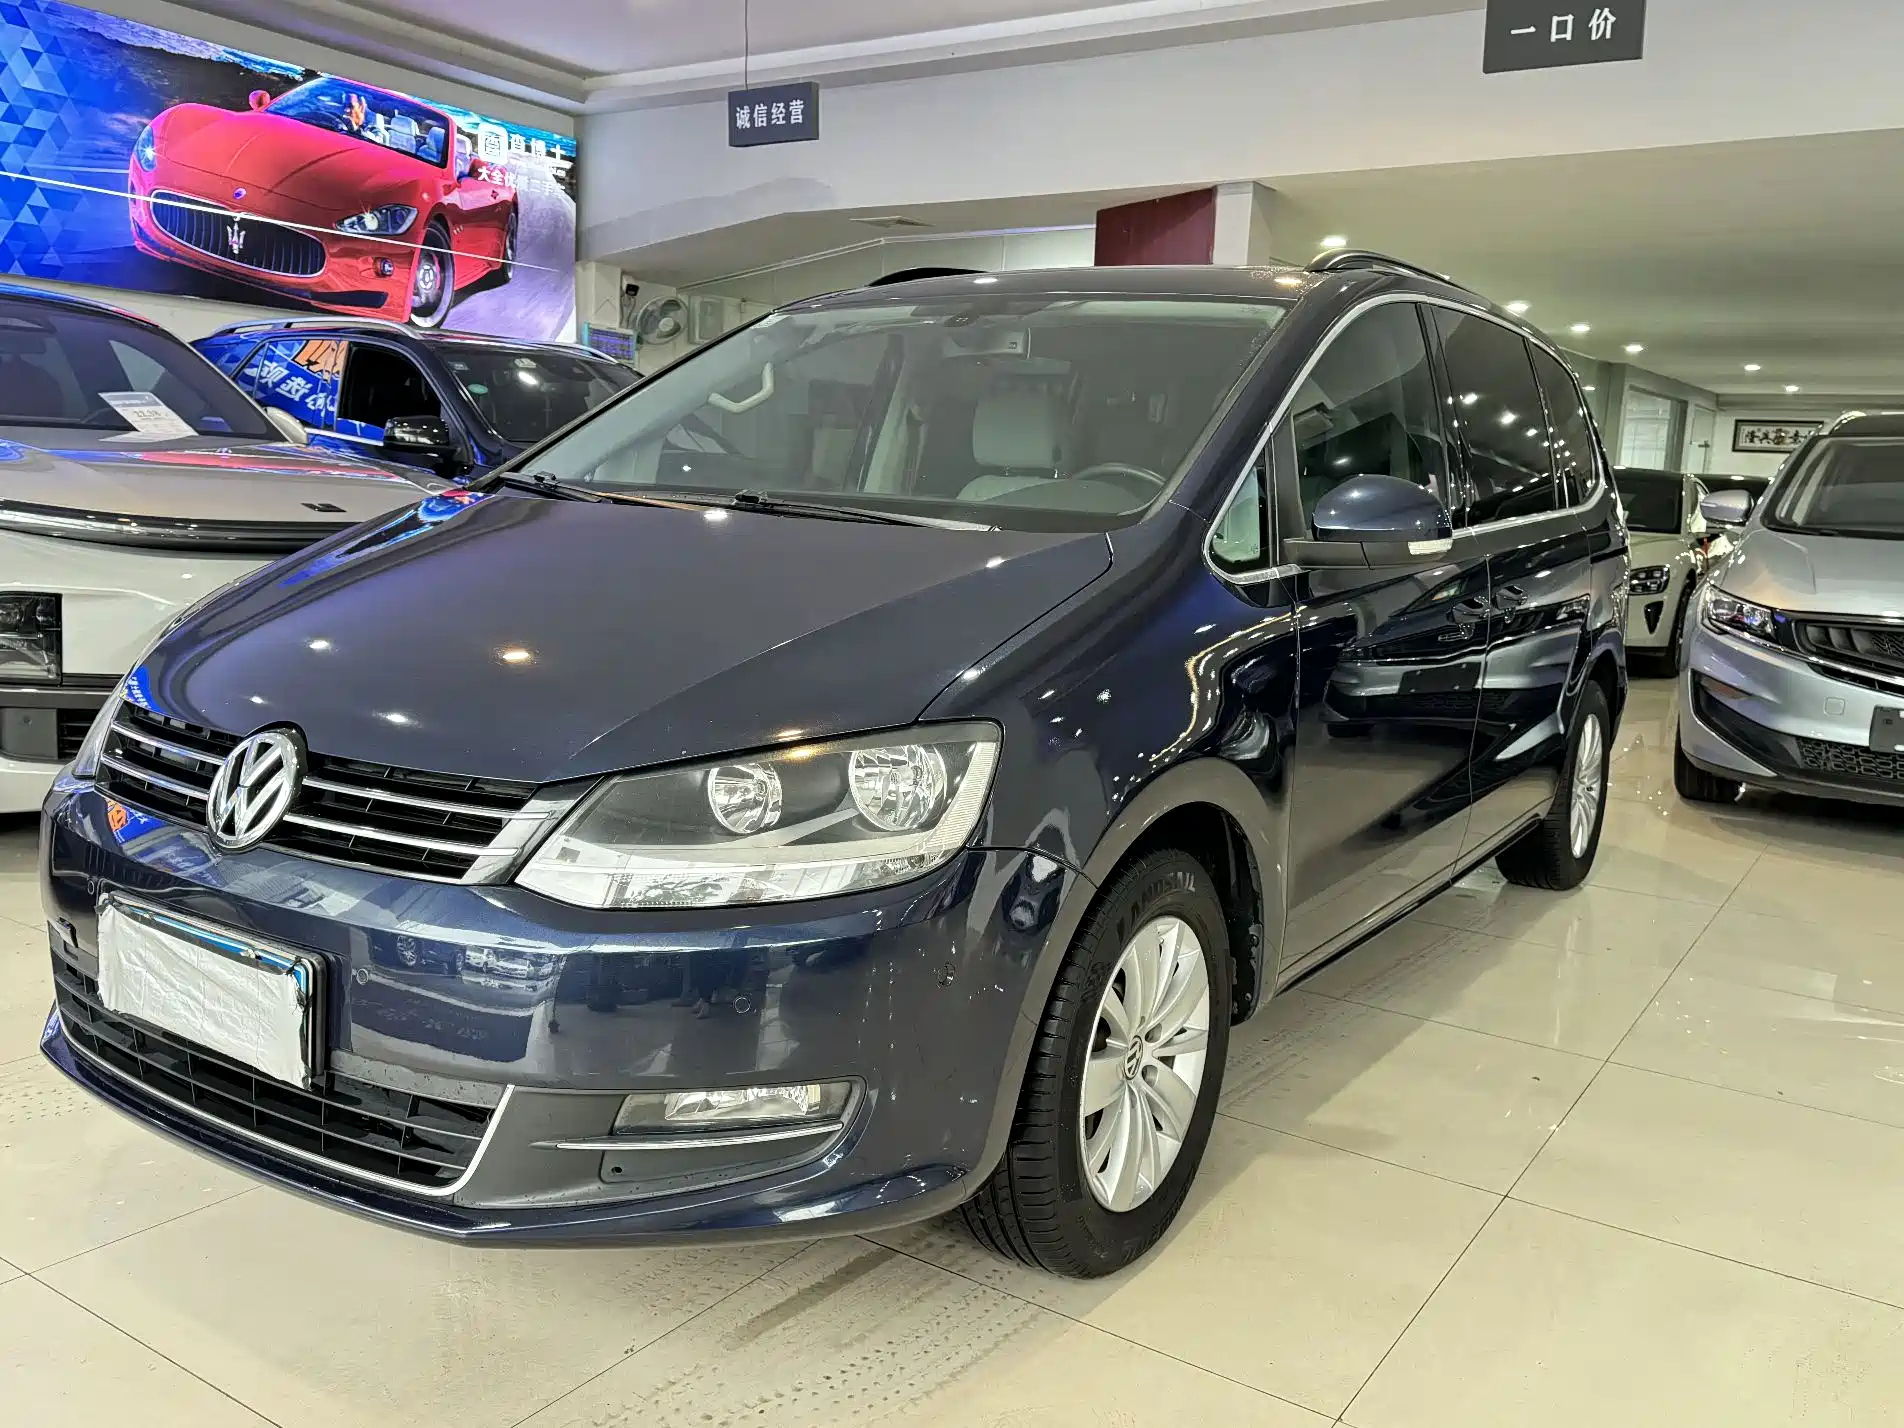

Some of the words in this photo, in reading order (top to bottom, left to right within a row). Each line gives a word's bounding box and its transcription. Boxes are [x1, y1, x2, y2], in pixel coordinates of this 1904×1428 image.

[1510, 7, 1617, 43] 一口价
[735, 99, 805, 129] 诚信经营
[478, 166, 566, 196] 大全优二手
